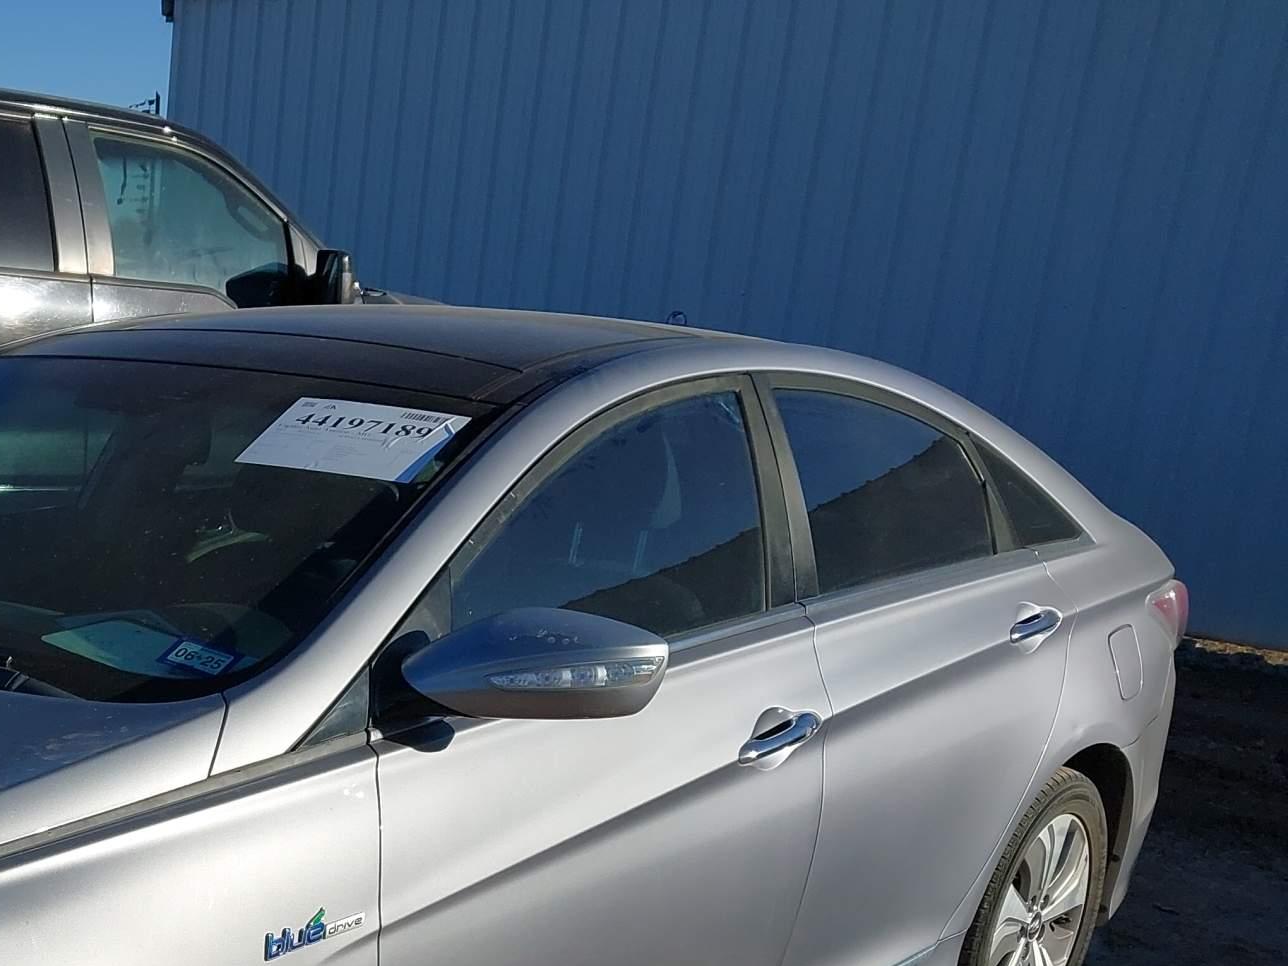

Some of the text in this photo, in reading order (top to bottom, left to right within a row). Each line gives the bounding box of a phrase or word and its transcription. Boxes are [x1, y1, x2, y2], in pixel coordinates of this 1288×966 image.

[295, 413, 432, 439] 44197189
[264, 908, 363, 961] blue drive
